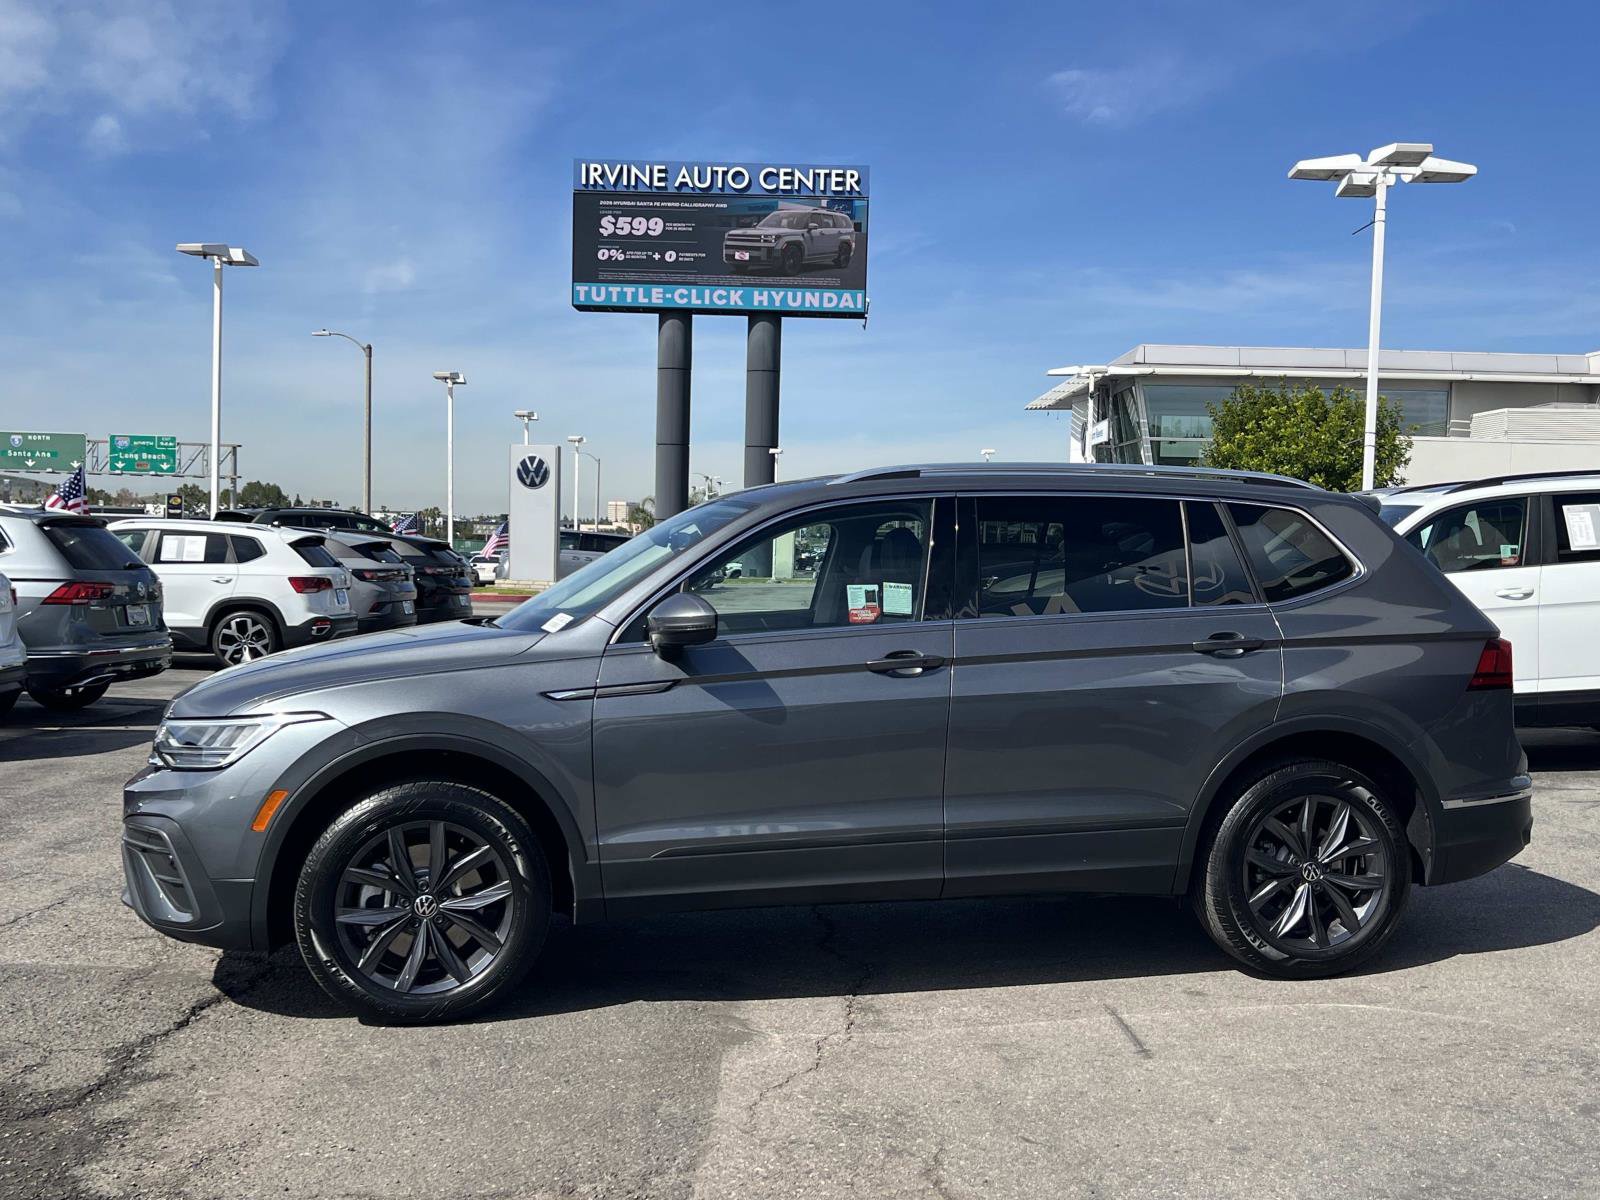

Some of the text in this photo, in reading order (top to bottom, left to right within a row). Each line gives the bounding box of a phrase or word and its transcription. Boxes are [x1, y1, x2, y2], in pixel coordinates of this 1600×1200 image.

[581, 163, 860, 192] IRVINE AUTO CENTER
[599, 215, 664, 237] $599
[598, 248, 625, 261] 0%
[664, 250, 676, 262] 0
[575, 285, 863, 309] TUTTLE-CLICK HYUNDAI
